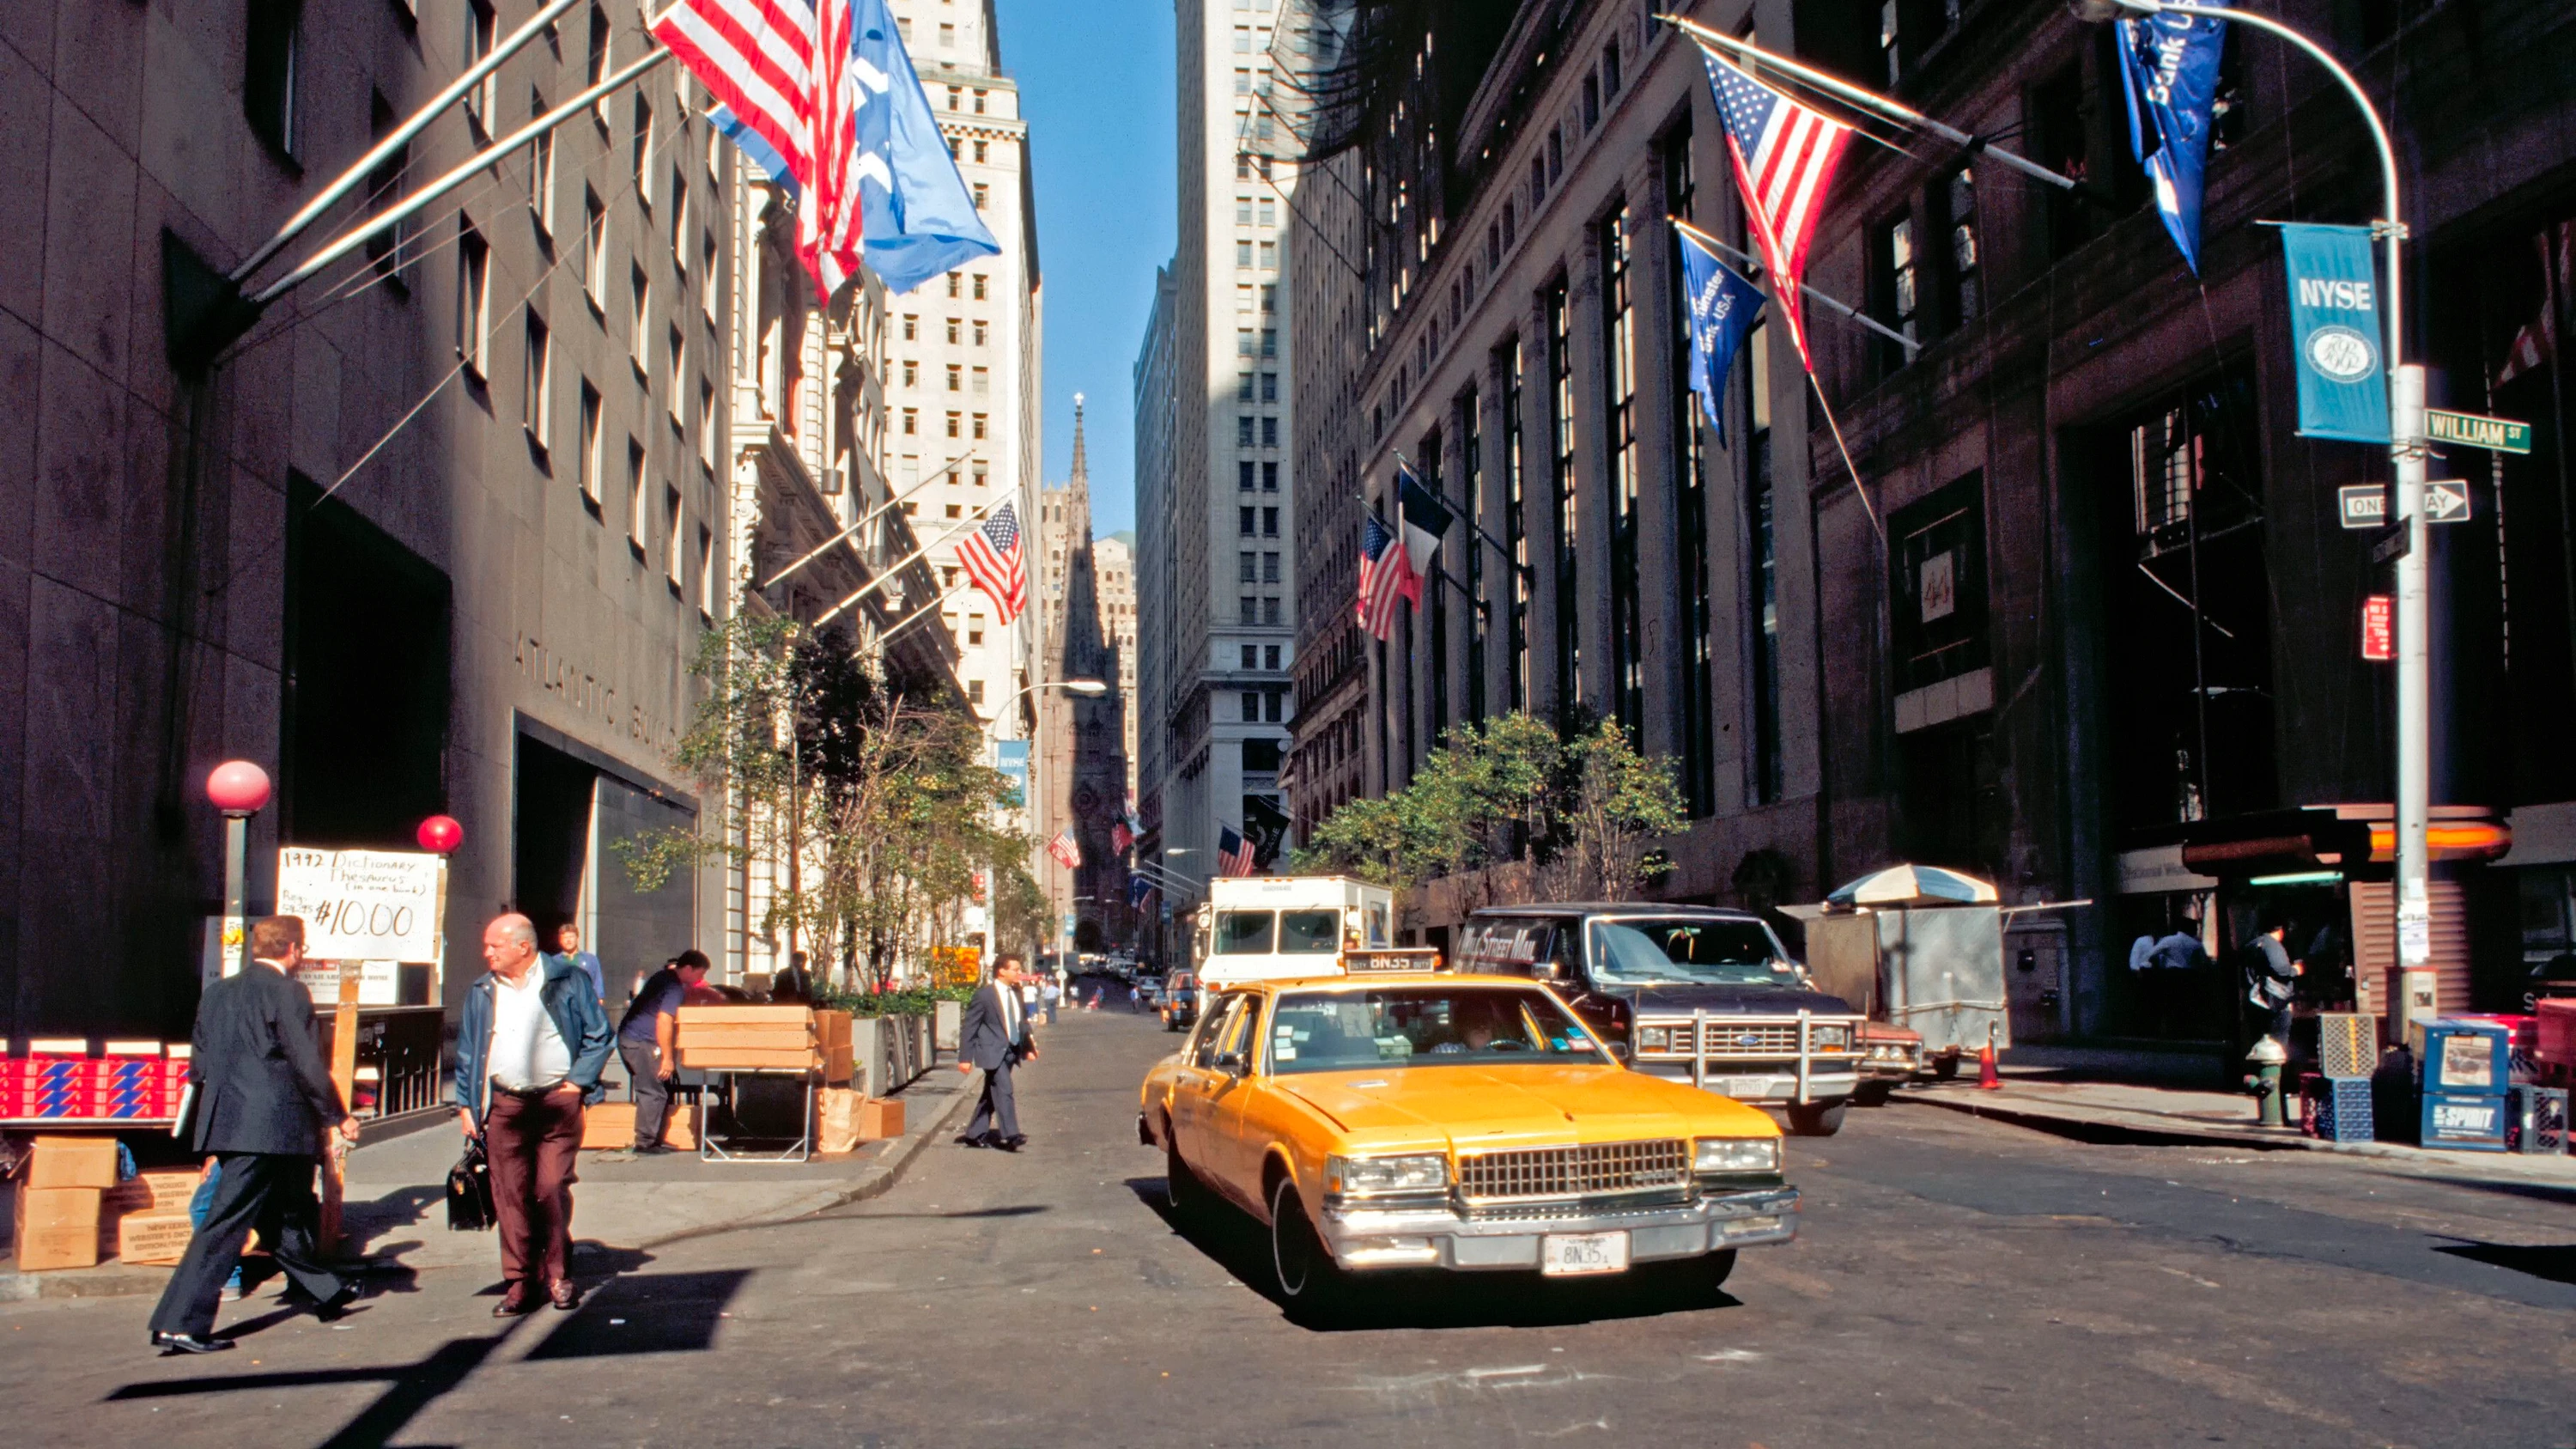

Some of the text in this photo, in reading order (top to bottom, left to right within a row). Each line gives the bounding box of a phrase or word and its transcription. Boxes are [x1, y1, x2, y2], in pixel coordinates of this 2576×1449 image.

[2147, 36, 2187, 106] Bank
[2299, 277, 2372, 310] NYSE
[1713, 294, 1735, 320] USA
[2431, 414, 2522, 446] WILLIAM ST
[2427, 495, 2448, 508] AY
[1924, 566, 1950, 608] 44
[515, 630, 616, 725] ATLANTIC
[999, 757, 1025, 768] NYSE
[285, 852, 323, 868] 1992
[314, 898, 413, 937] $10.00
[2445, 1107, 2494, 1128] SPIRIT
[147, 1222, 167, 1231] NEW
[1564, 1245, 1601, 1264] 8N35
